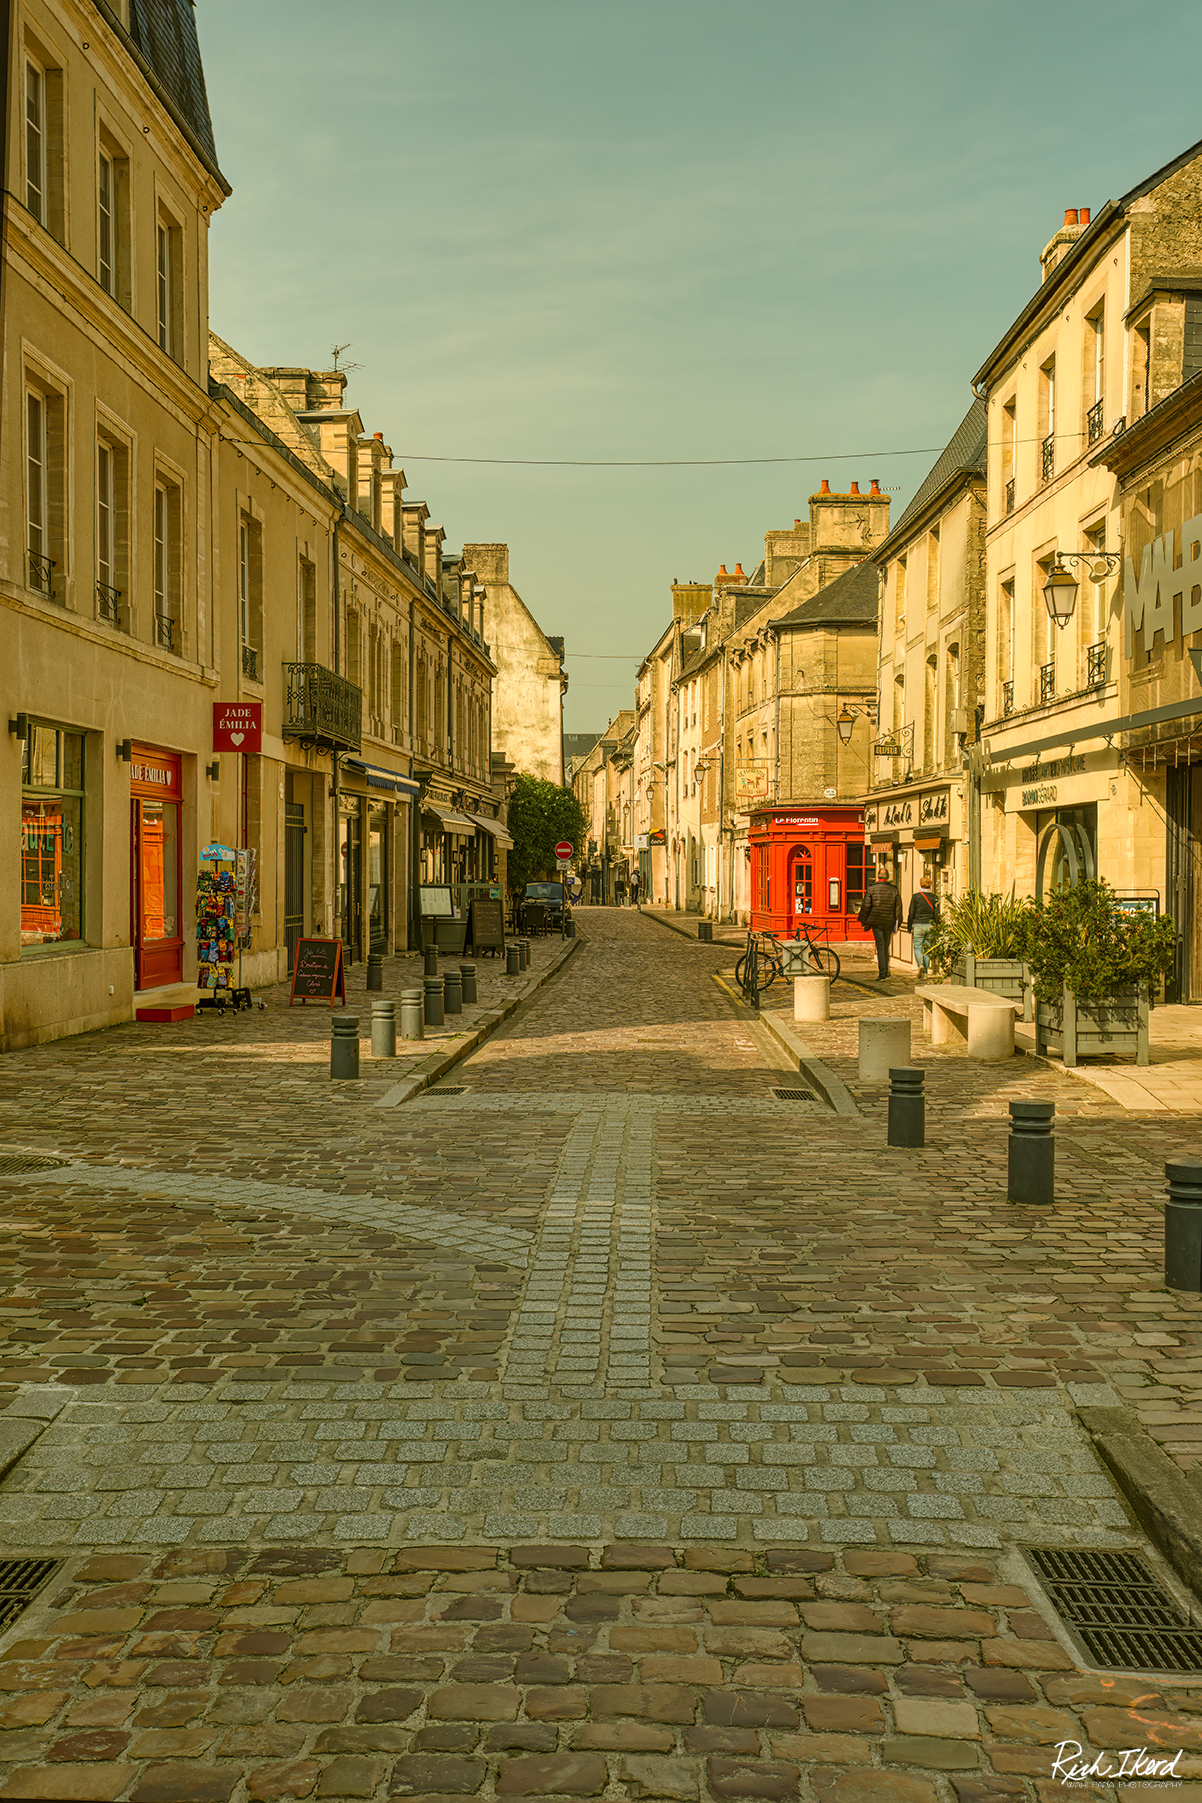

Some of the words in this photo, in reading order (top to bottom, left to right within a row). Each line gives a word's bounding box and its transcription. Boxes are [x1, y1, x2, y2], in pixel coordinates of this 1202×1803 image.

[224, 708, 252, 718] JADE
[219, 718, 257, 730] ÉMILIA
[130, 764, 144, 781] ADE
[144, 763, 167, 785] ÉMILIA
